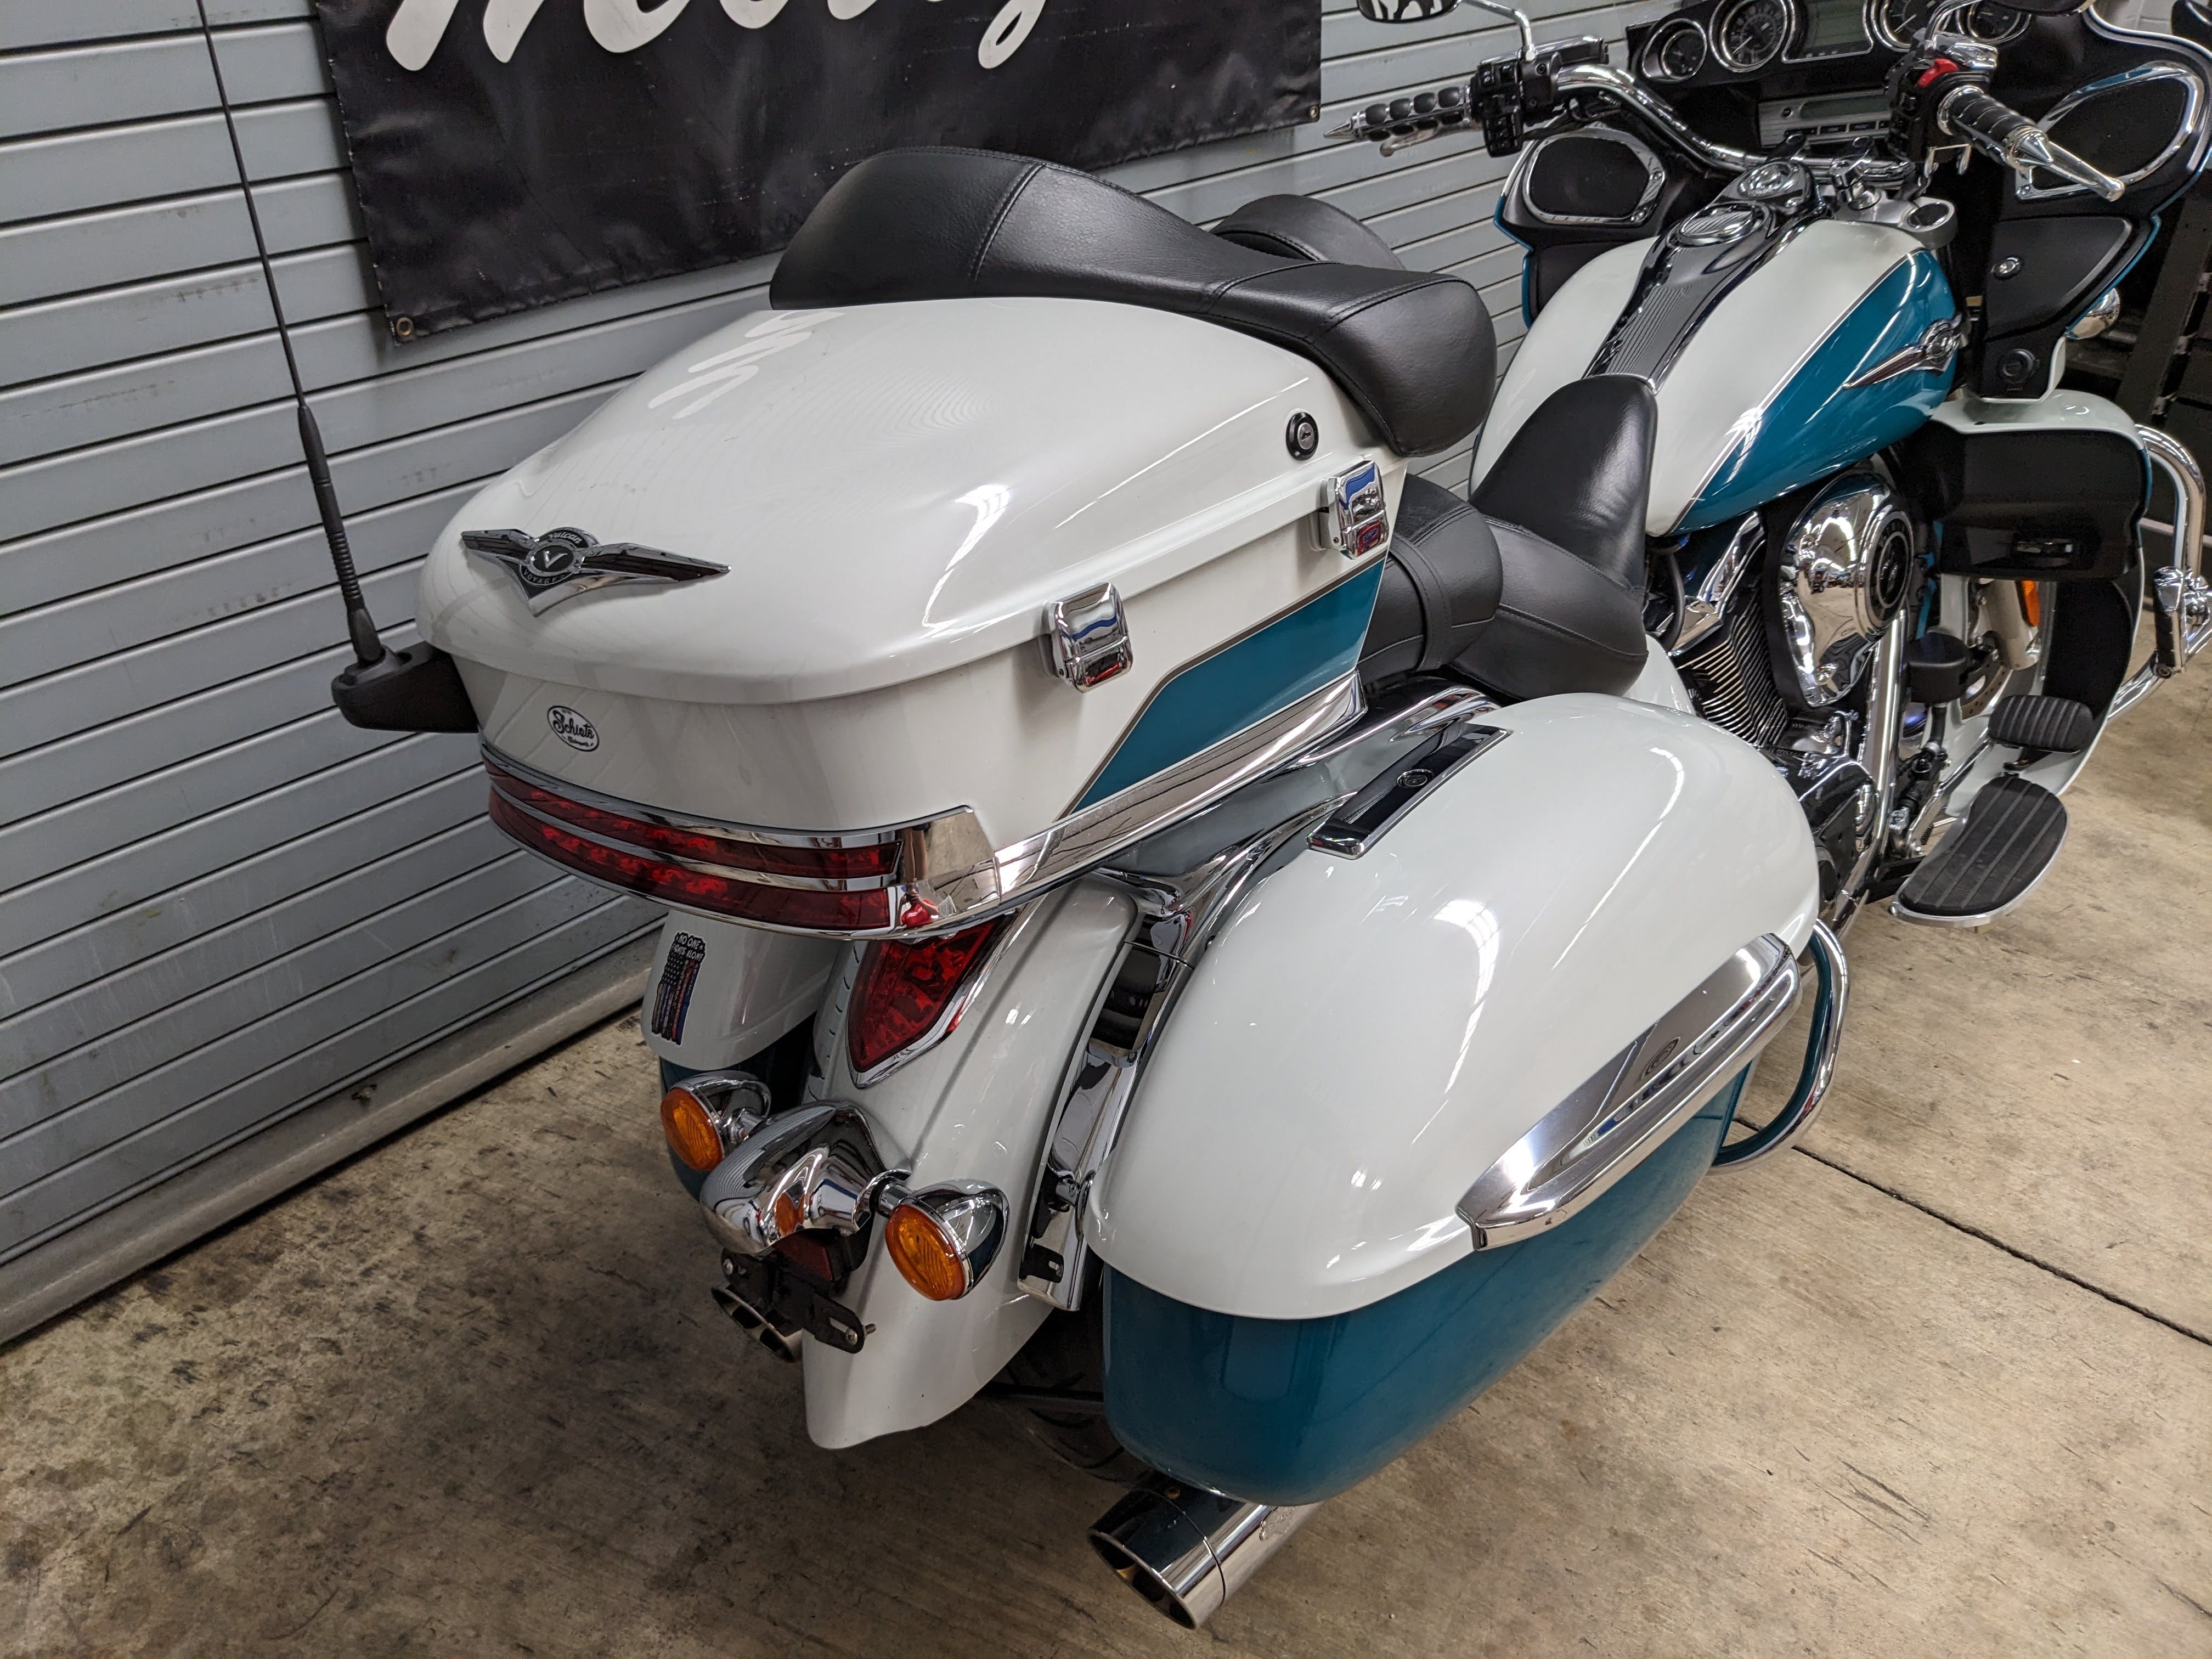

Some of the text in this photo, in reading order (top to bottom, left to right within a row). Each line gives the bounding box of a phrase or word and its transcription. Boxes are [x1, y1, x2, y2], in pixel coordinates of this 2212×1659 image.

[523, 568, 566, 584] VOYAGE
[678, 934, 701, 950] NO ONE
[686, 950, 703, 961] ALONE
